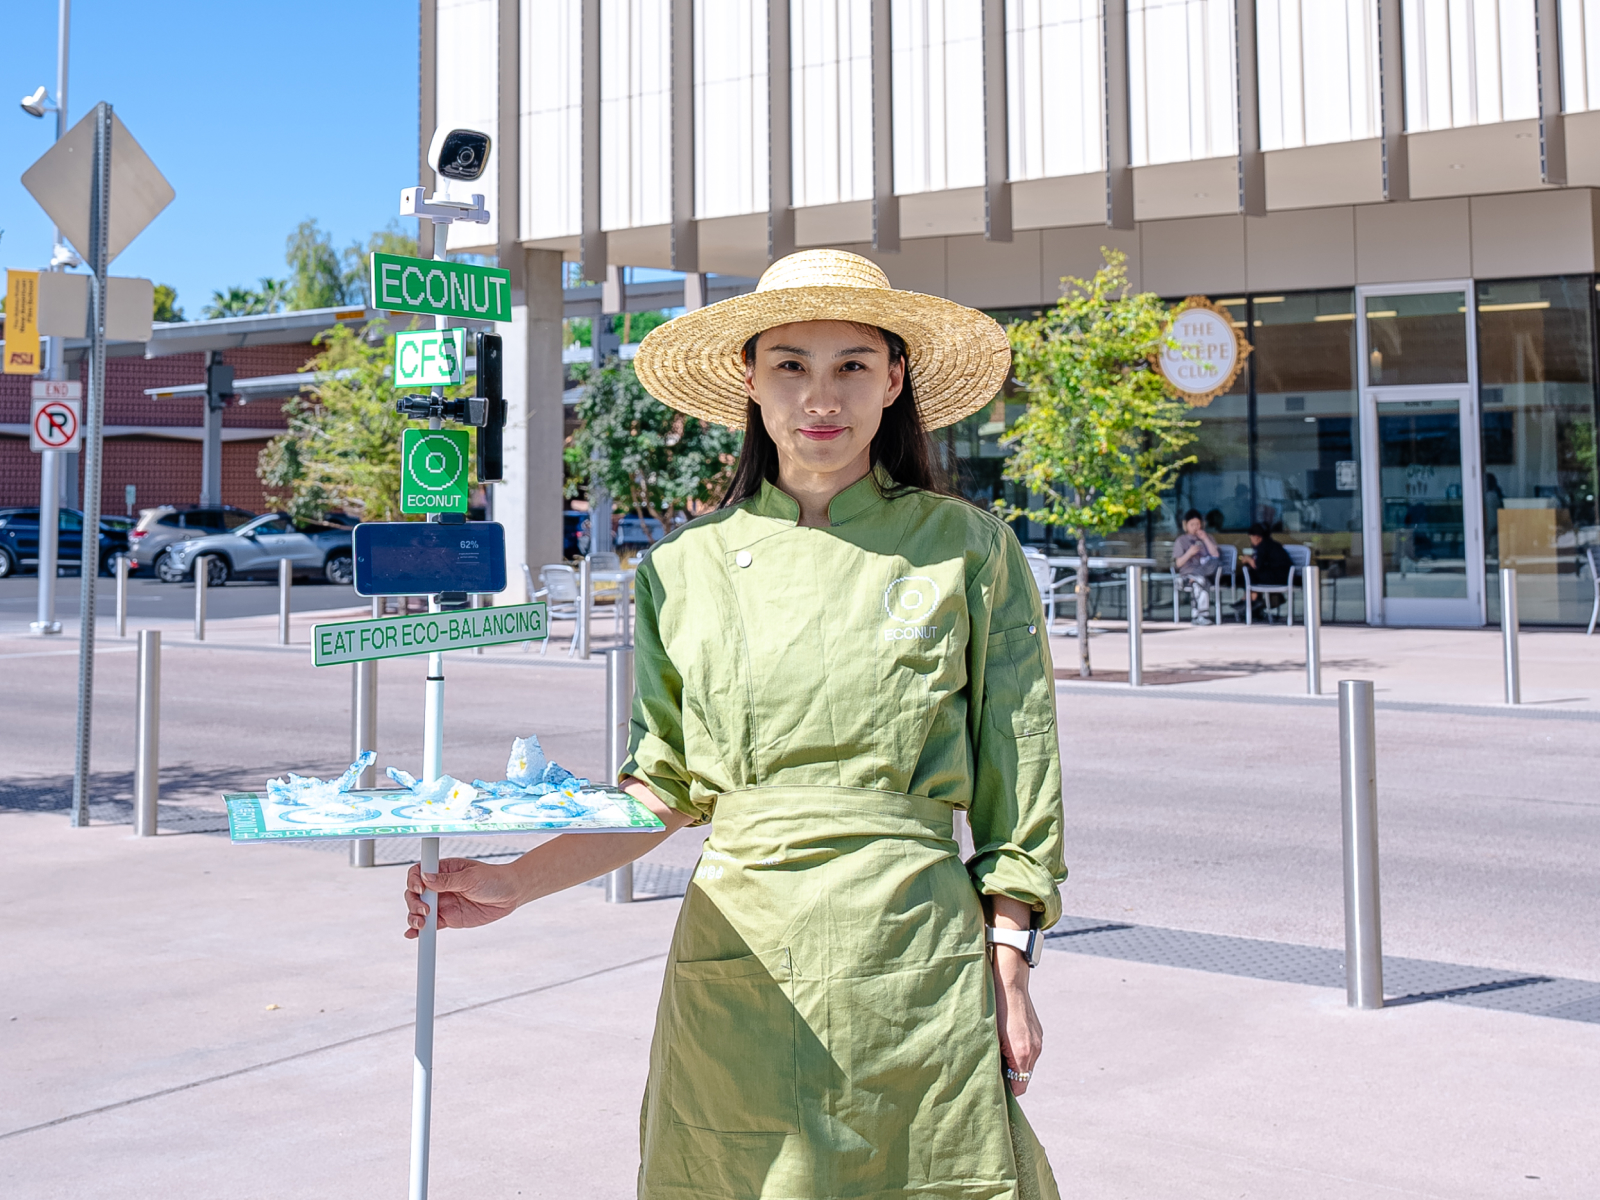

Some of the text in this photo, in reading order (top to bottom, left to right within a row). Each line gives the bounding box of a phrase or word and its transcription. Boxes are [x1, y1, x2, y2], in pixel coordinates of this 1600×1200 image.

[381, 263, 506, 315] ECONUT
[1181, 321, 1215, 337] THE
[399, 337, 457, 378] CFS
[45, 383, 69, 397] END
[407, 494, 461, 507] ECONUT
[460, 540, 479, 549] 62%
[320, 610, 541, 656] EAT FOR ECO-BALANCING
[884, 626, 938, 641] ECONUT
